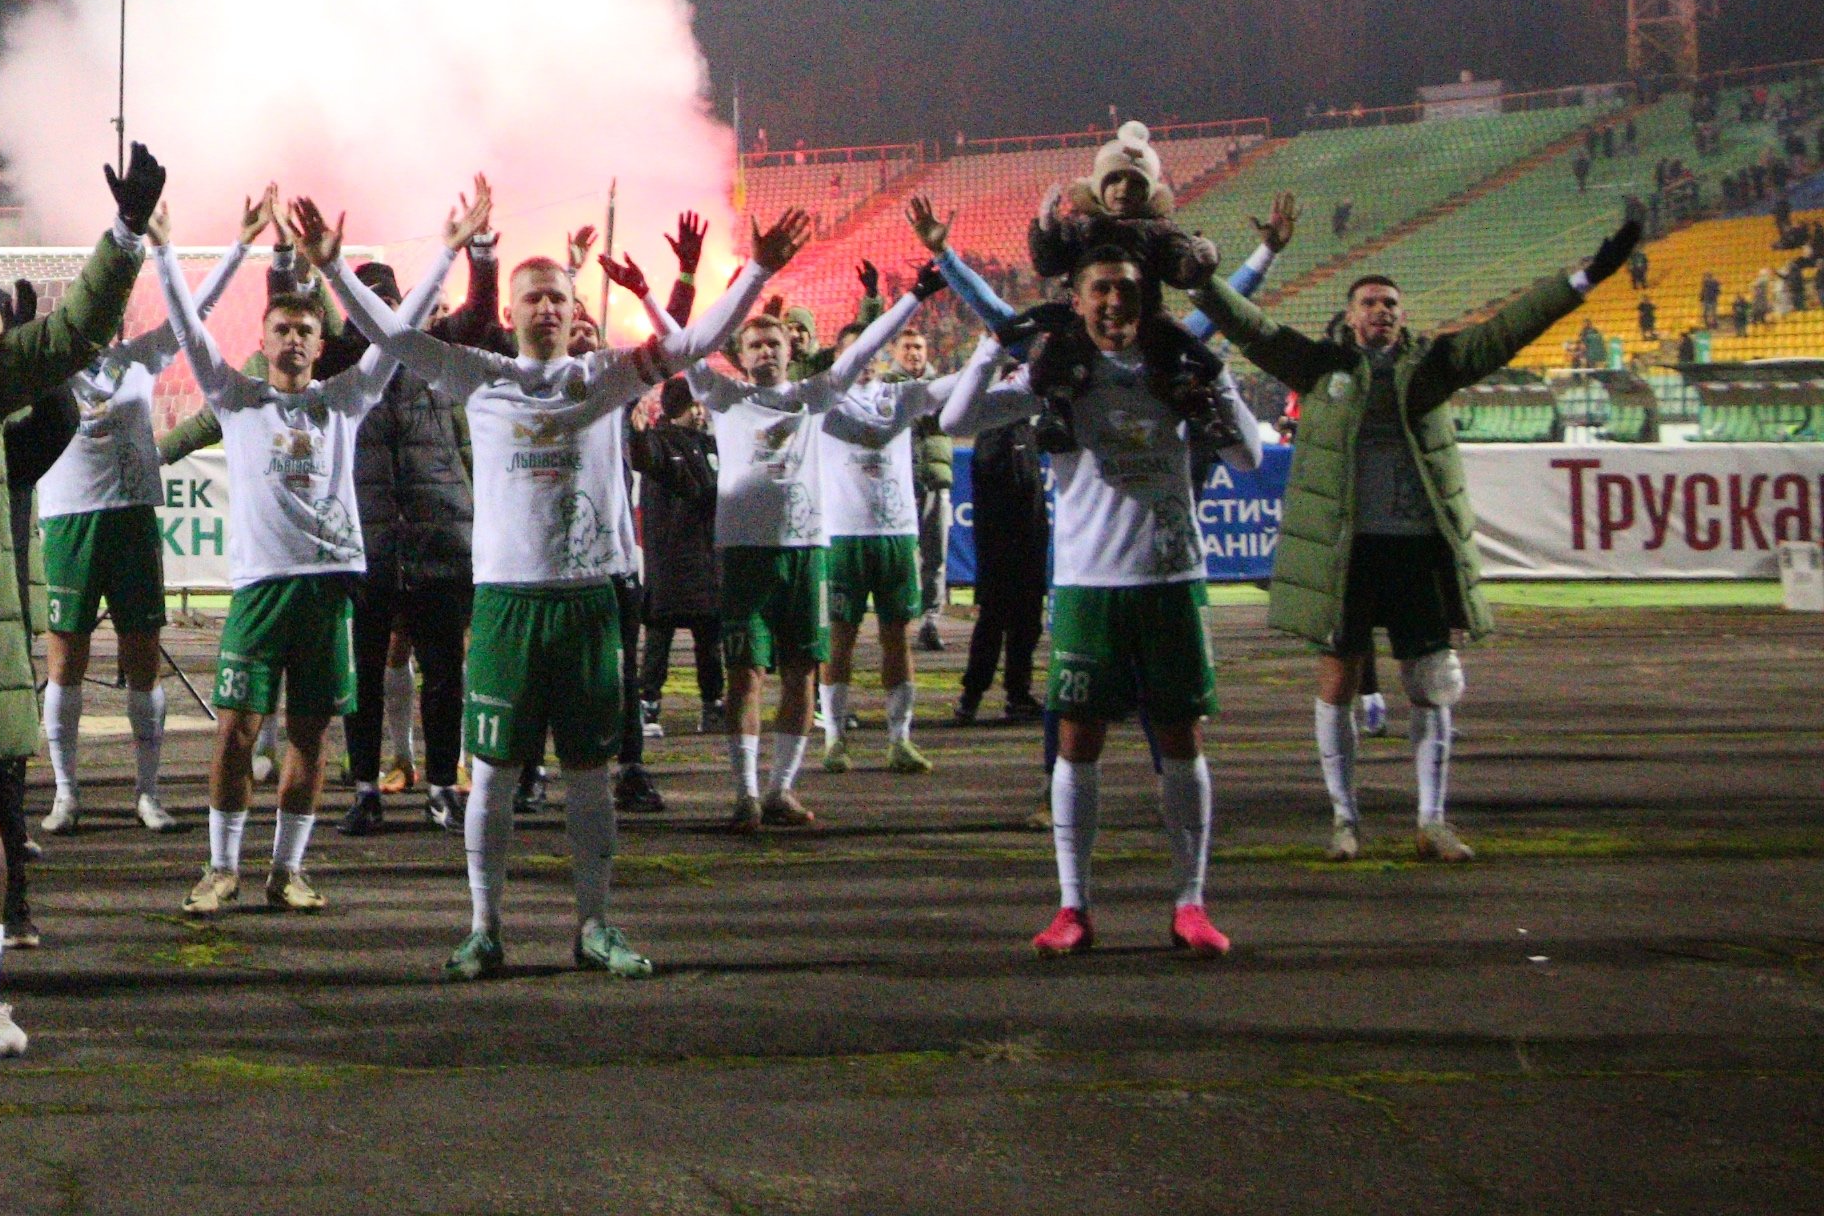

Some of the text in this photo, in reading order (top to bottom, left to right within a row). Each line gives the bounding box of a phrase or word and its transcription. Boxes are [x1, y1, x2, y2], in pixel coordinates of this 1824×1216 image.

[1551, 459, 1824, 552] Труска
[50, 599, 60, 624] 3
[219, 668, 250, 701] 33
[477, 712, 500, 749] 11
